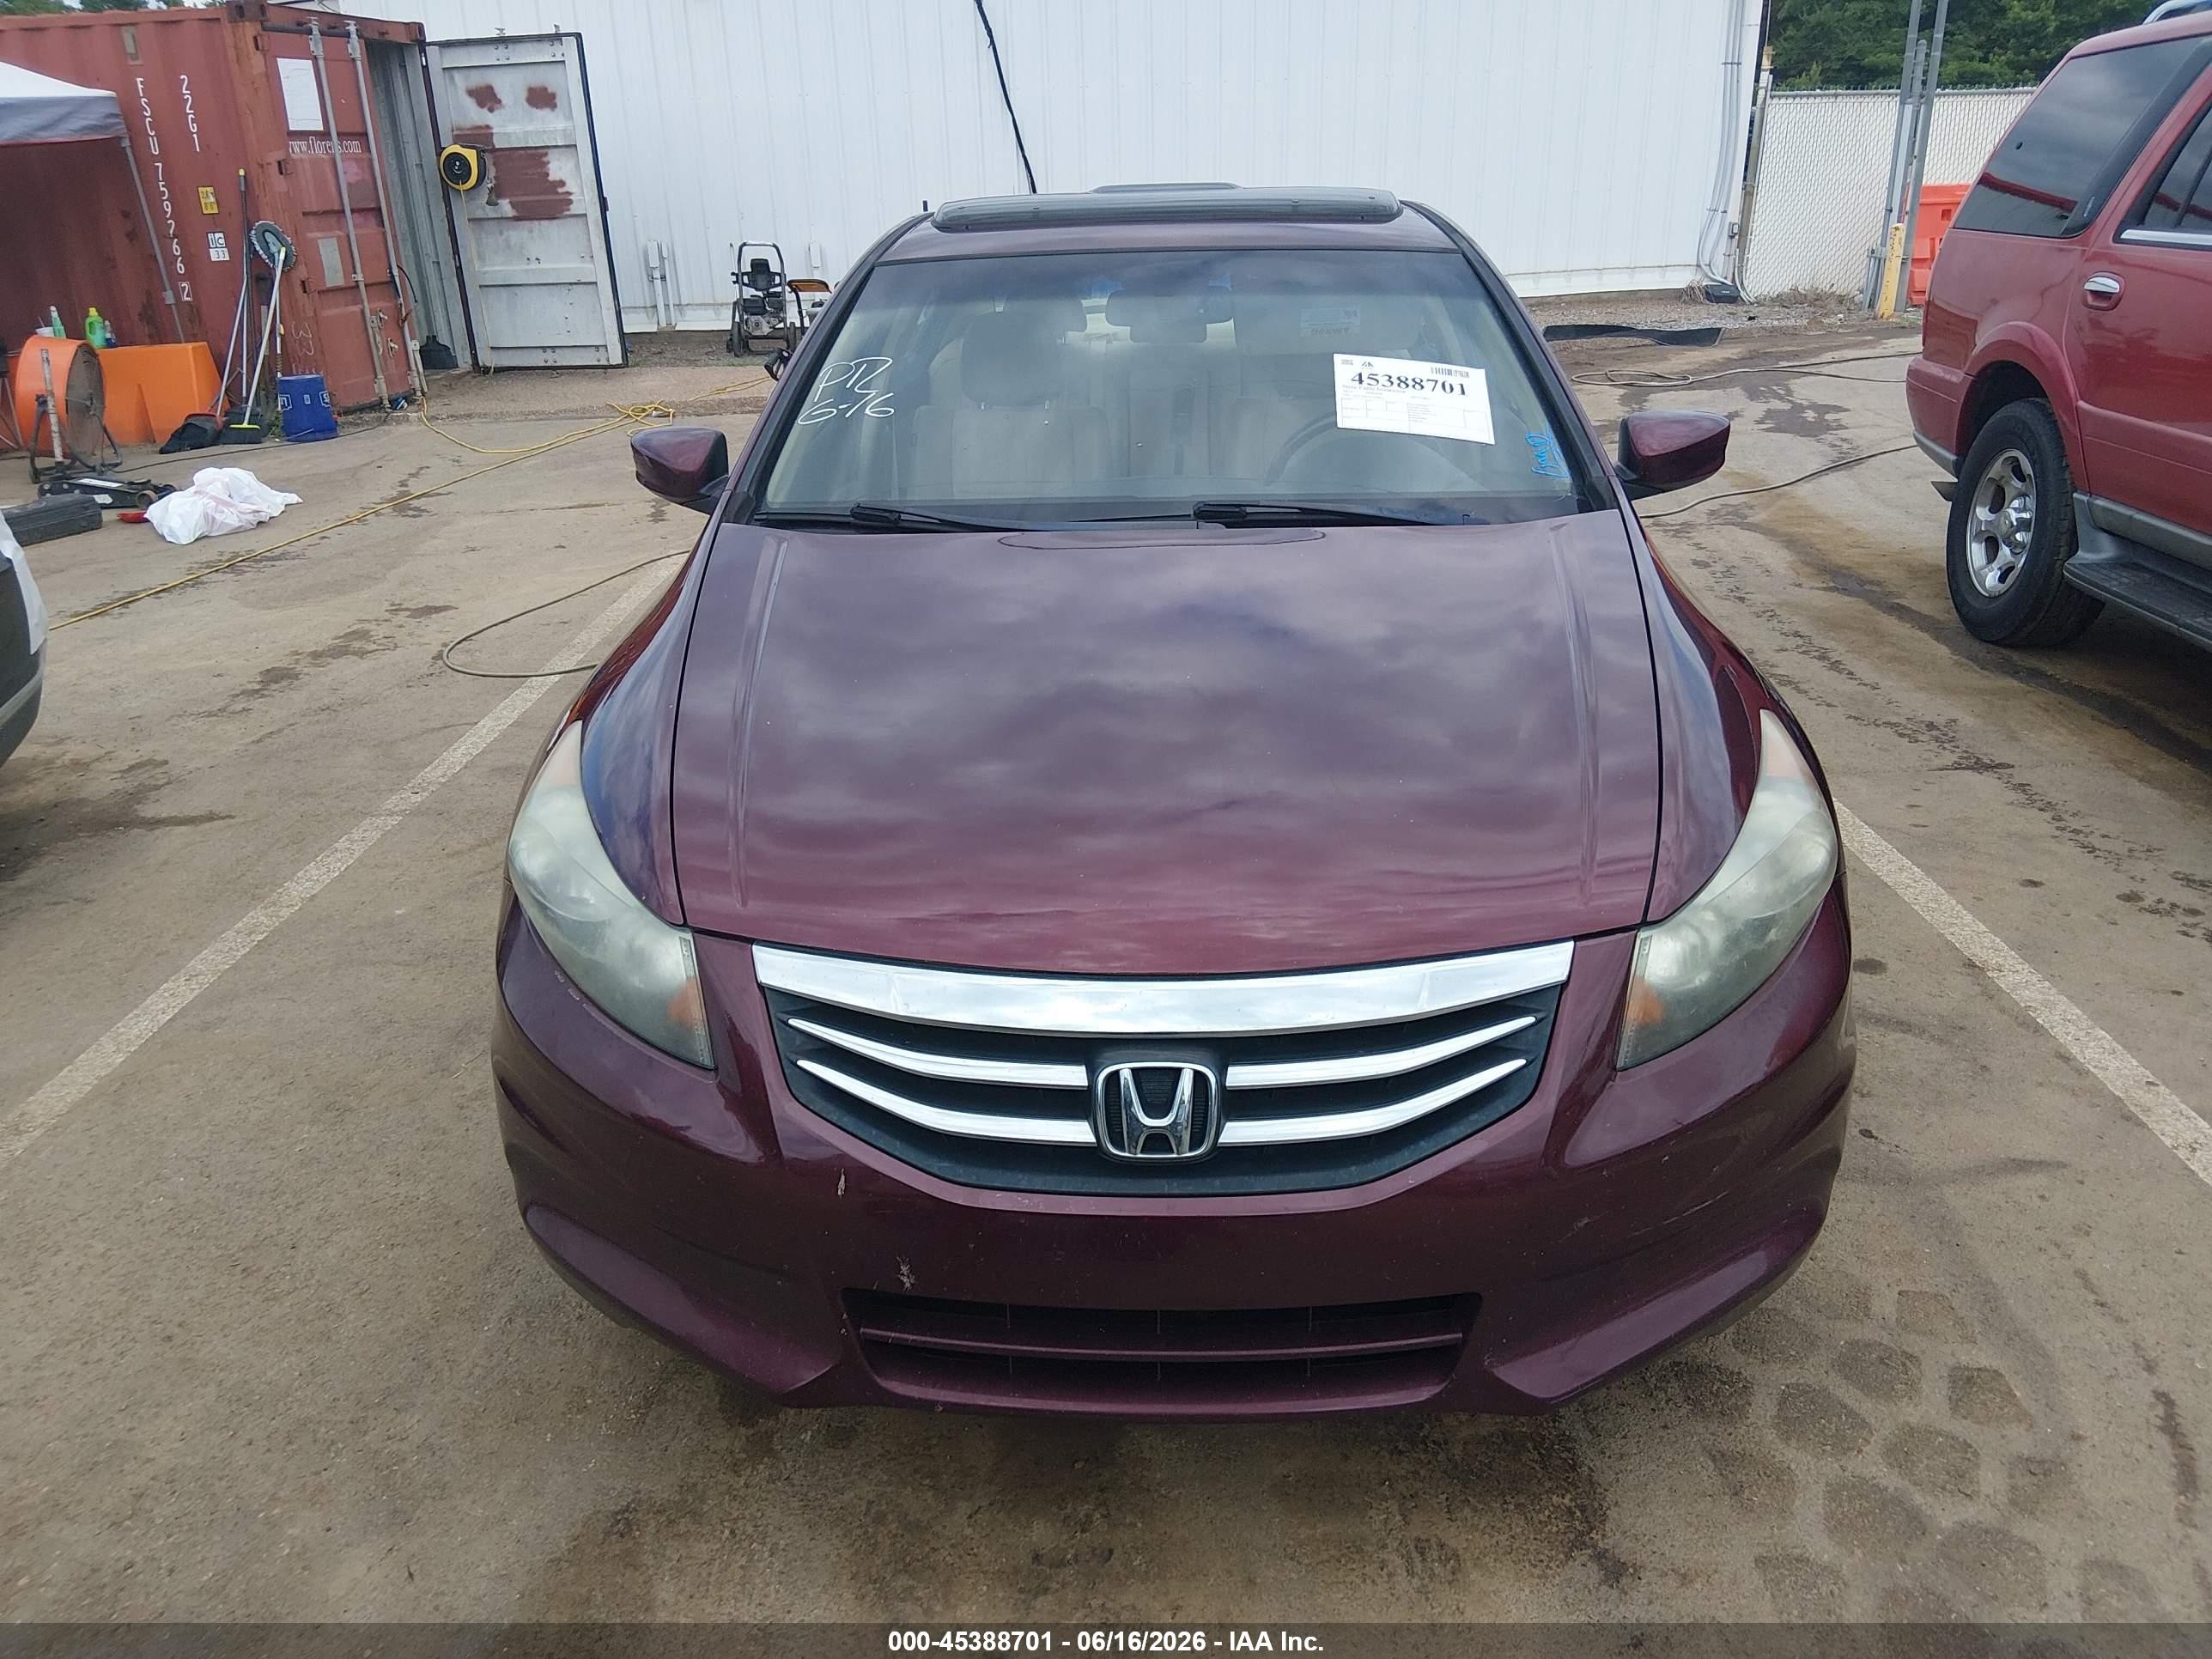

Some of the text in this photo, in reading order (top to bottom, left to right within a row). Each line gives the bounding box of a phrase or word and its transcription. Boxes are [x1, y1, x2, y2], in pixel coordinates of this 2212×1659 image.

[137, 77, 191, 301] FSCU 759766 2
[1351, 371, 1468, 397] 45388701
